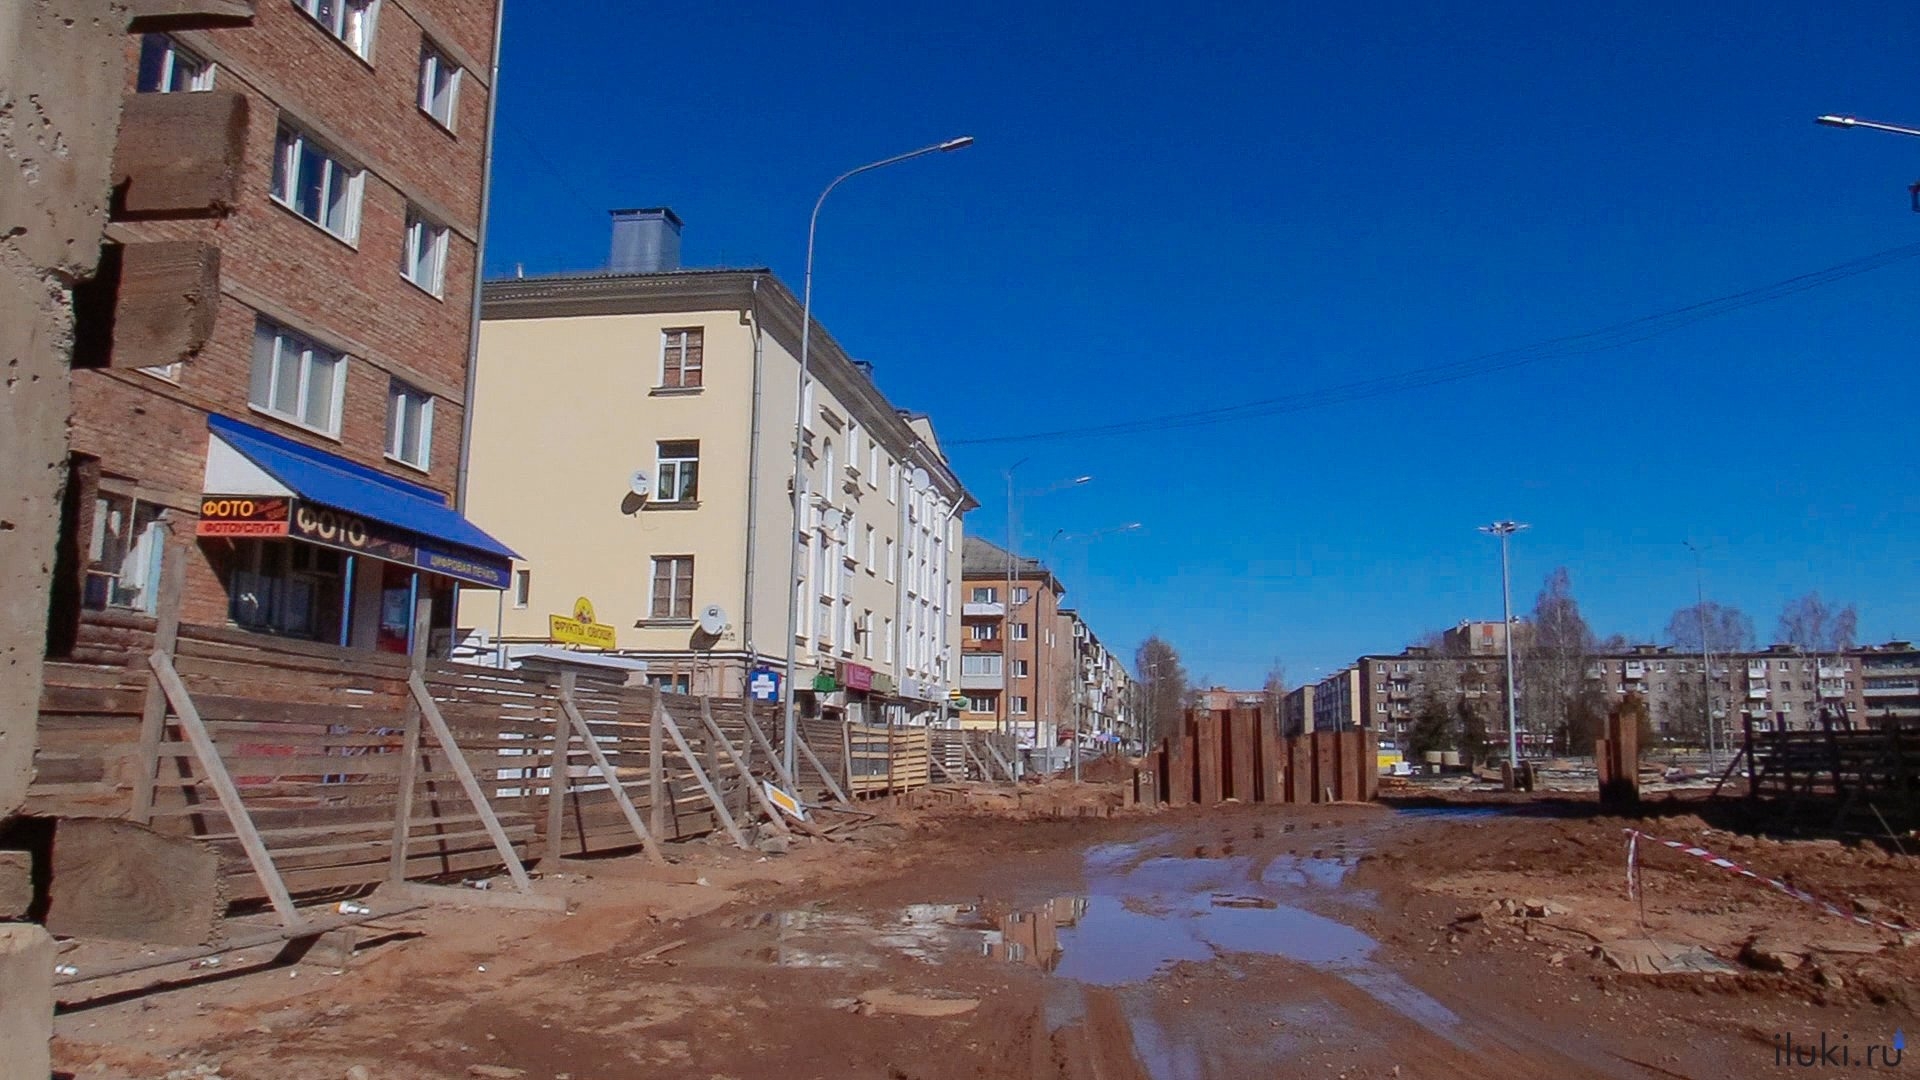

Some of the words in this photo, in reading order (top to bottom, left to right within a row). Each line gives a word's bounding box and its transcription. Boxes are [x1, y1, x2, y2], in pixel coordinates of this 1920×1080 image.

[202, 500, 255, 517] ФОТО
[204, 522, 281, 534] ФОТОУСЛУГИ
[297, 507, 367, 547] ФОТО
[554, 620, 585, 636] ФРУКТЫ
